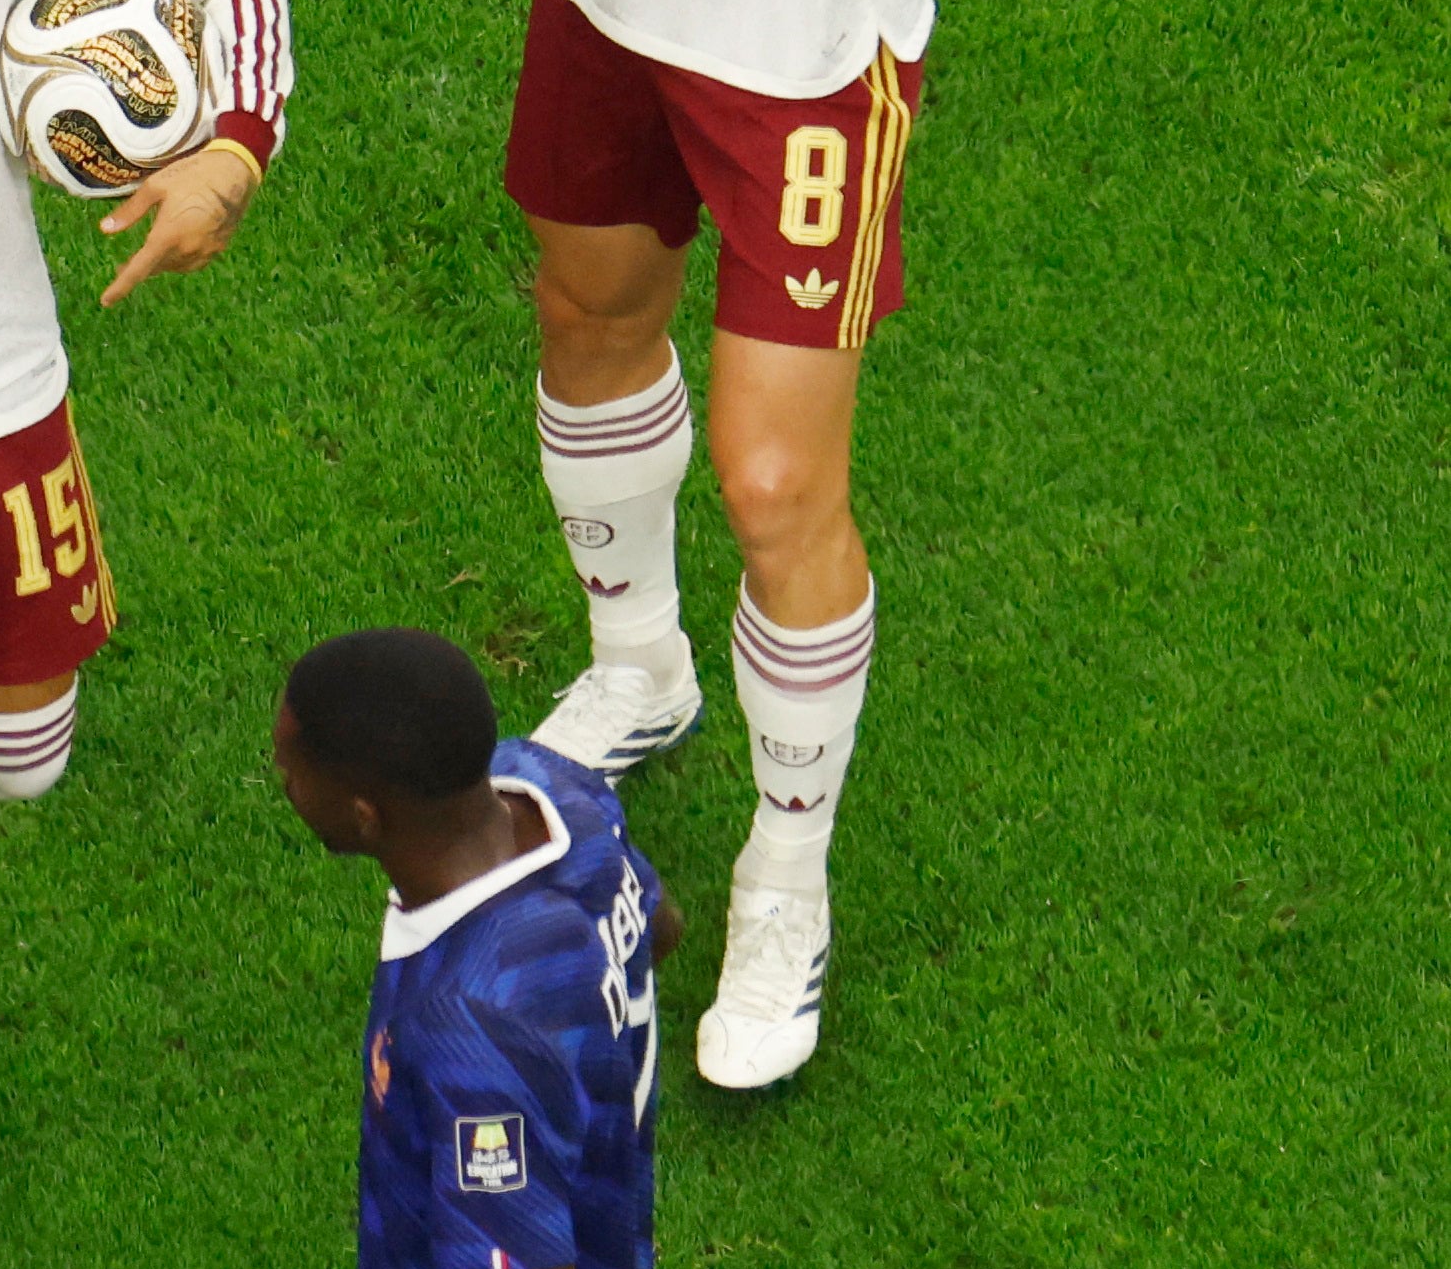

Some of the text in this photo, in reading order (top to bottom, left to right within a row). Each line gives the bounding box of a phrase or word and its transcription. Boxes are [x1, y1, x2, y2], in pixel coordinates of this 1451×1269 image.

[55, 131, 97, 158] NEW
[779, 126, 848, 247] 8
[2, 451, 87, 597] 15
